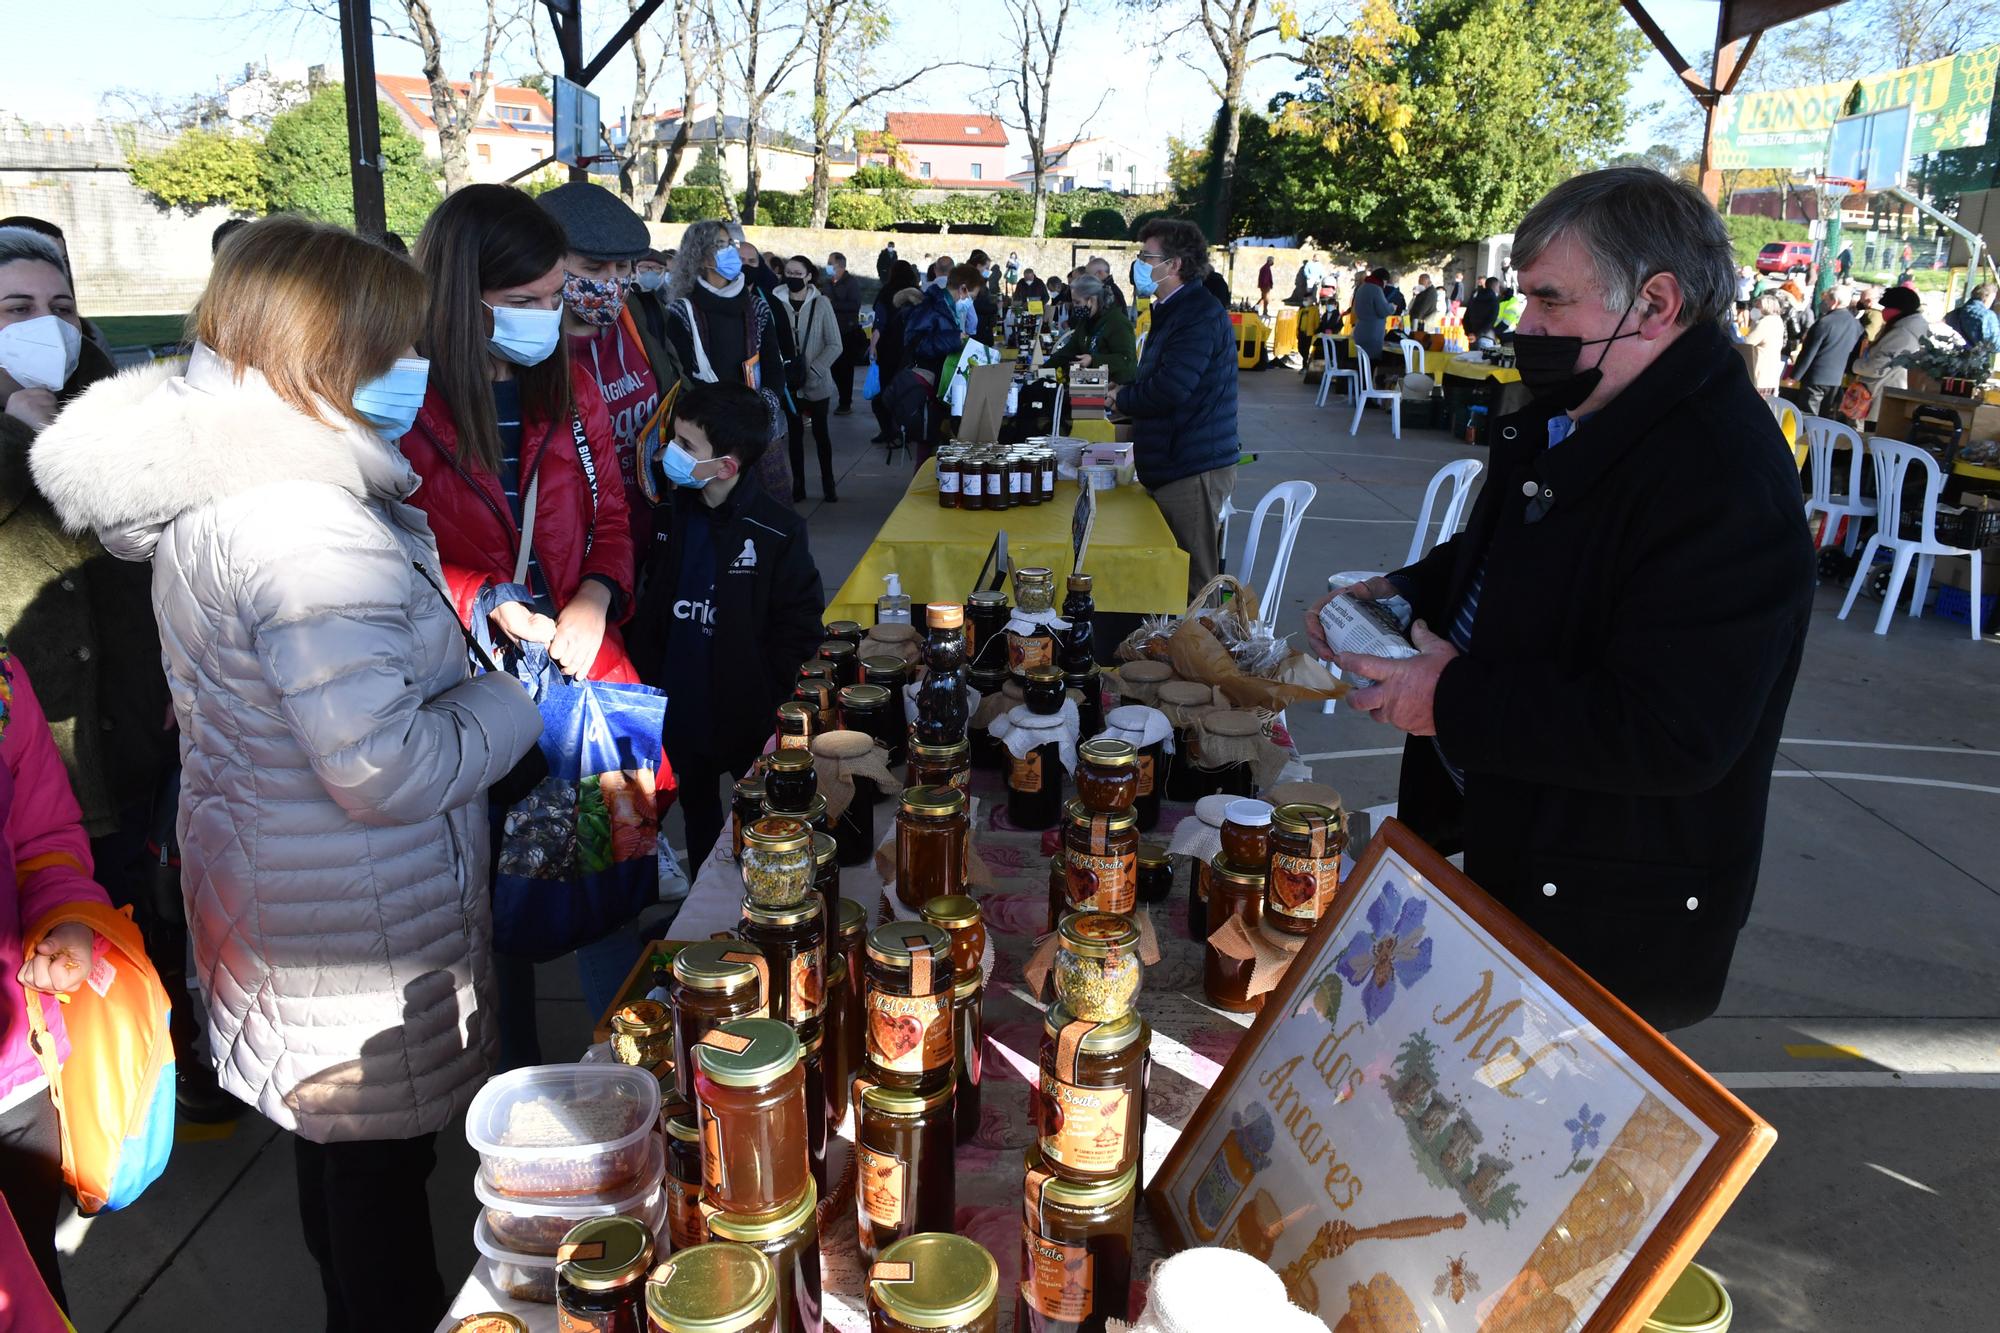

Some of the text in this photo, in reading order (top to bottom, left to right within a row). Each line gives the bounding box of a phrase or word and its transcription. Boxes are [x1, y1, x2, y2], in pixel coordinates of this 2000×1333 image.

[578, 445, 596, 484] BIMBA
[1312, 1021, 1364, 1103] dos
[1433, 969, 1578, 1098] Mel
[1062, 1087, 1102, 1108] Souto
[1259, 1055, 1363, 1211] Ancares
[1034, 1239, 1065, 1262] Souto
